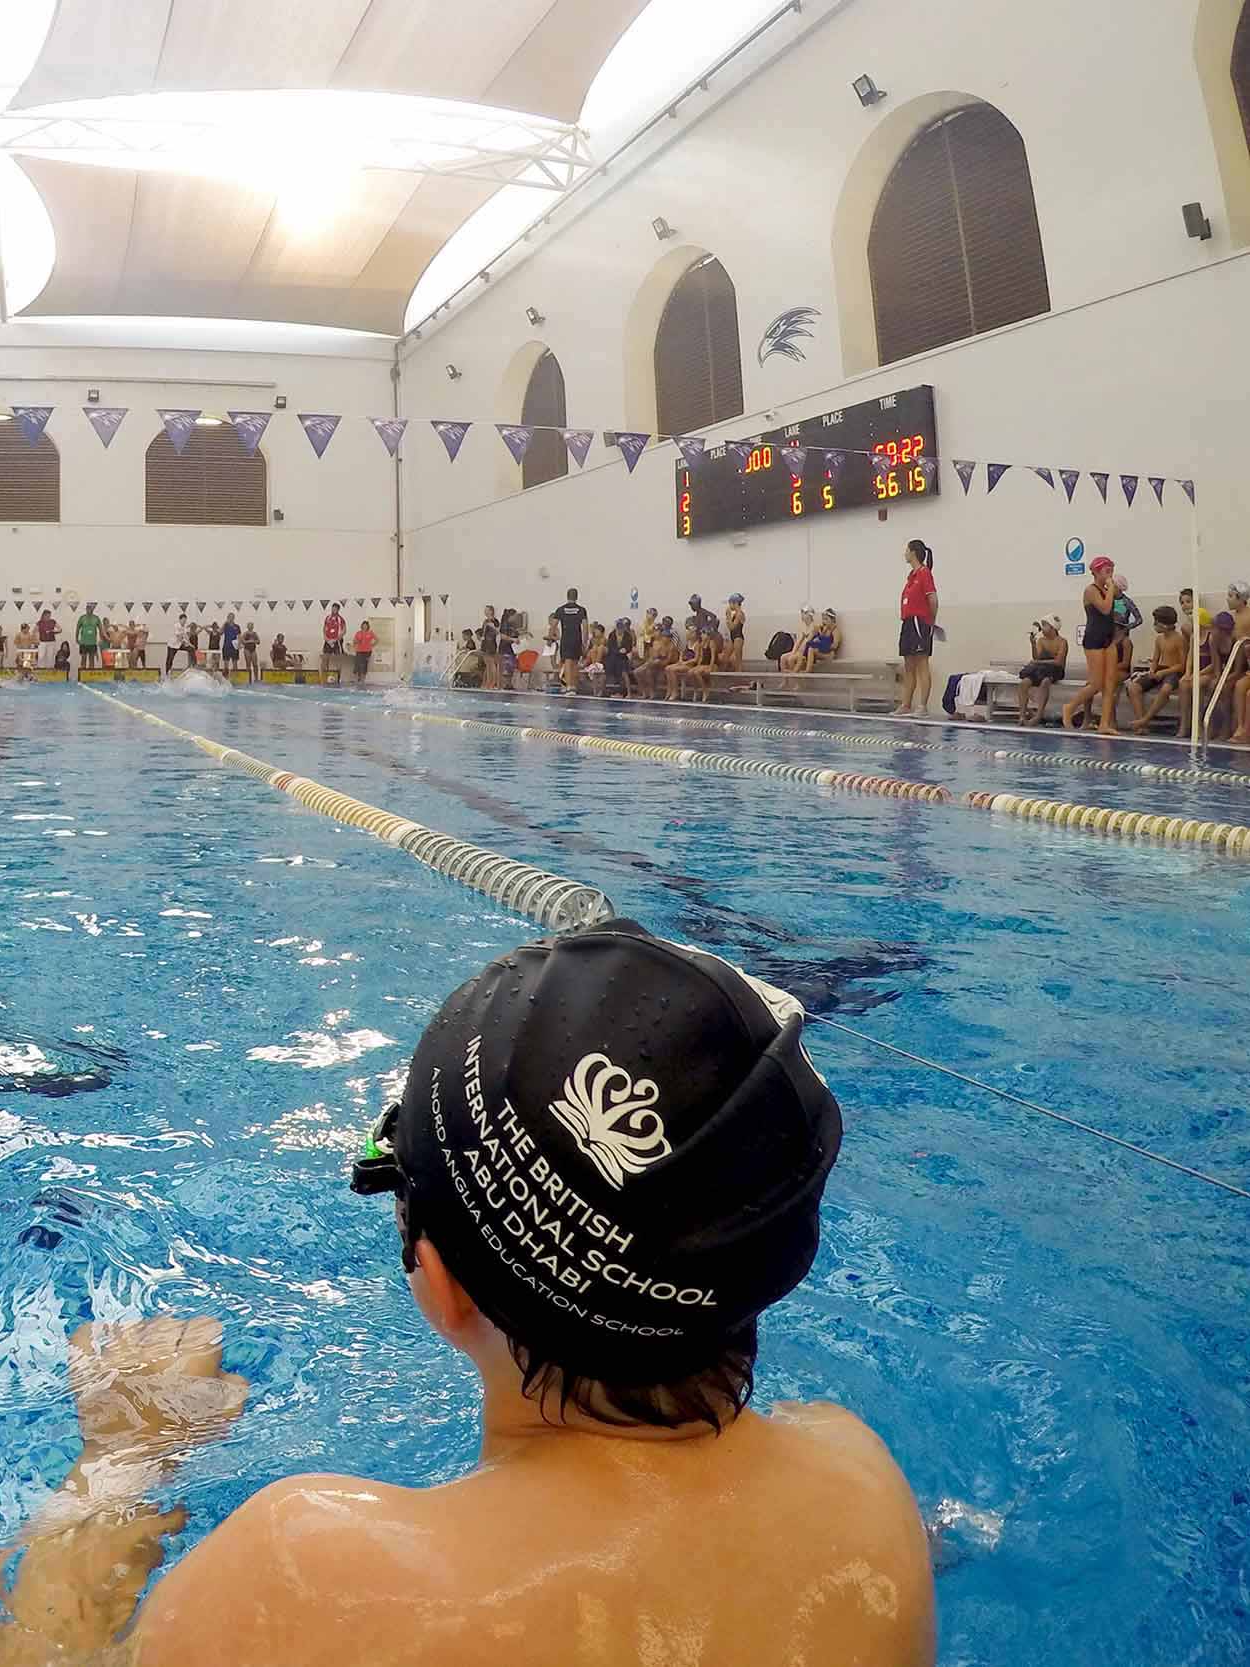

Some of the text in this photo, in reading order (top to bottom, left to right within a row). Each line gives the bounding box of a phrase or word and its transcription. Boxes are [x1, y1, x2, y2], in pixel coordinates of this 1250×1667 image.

[878, 395, 897, 410] TIME
[822, 411, 844, 427] PLACE
[784, 424, 800, 438] LANE
[710, 446, 727, 460] PLACE
[680, 492, 691, 513] 2
[790, 491, 803, 515] 6
[822, 485, 834, 510] 5
[682, 515, 691, 536] 3
[462, 1034, 717, 1306] INTERNATIONAL SCHOOL
[496, 1098, 634, 1254] THE BRITISH
[431, 1067, 685, 1336] A NORD ANGLIA EDUCATION SCHOOL
[464, 1149, 592, 1294] ABU DHABI
